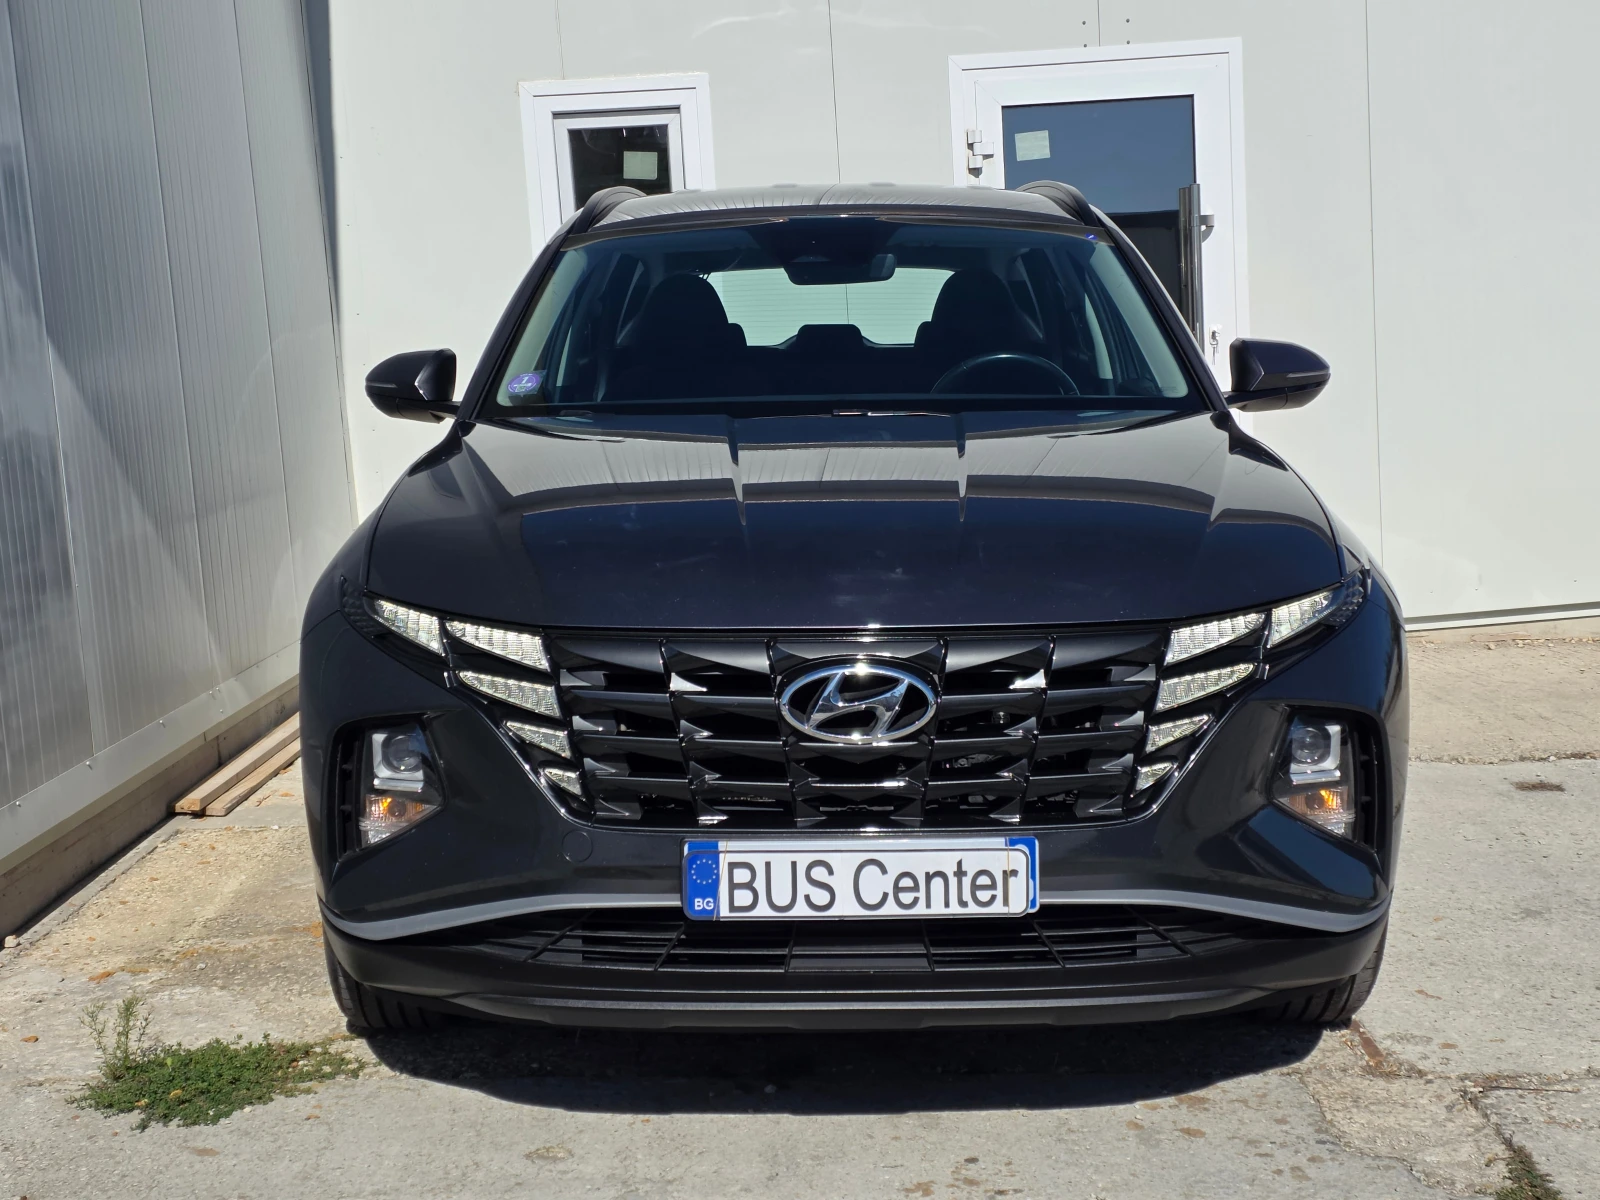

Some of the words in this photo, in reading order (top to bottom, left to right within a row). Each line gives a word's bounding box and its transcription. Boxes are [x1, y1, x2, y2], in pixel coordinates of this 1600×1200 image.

[727, 859, 836, 914] BUS
[852, 858, 1019, 912] Center
[694, 897, 714, 911] BG
